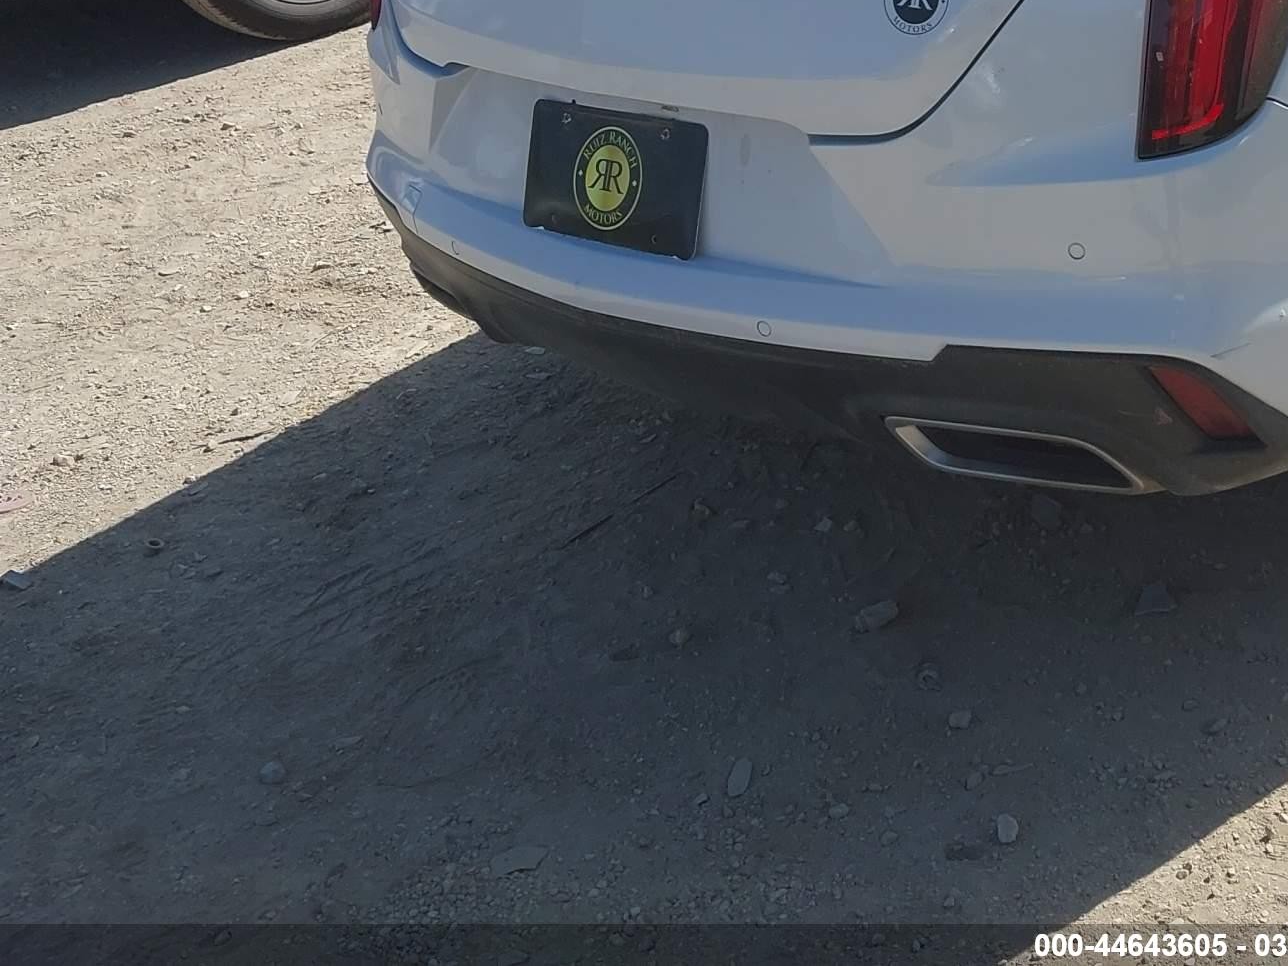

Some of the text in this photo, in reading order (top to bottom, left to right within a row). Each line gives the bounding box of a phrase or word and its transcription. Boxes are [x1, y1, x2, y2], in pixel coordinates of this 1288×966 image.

[893, 16, 933, 33] MOTORS
[583, 131, 638, 169] RUIZ RANCH
[583, 203, 623, 225] MOTORS
